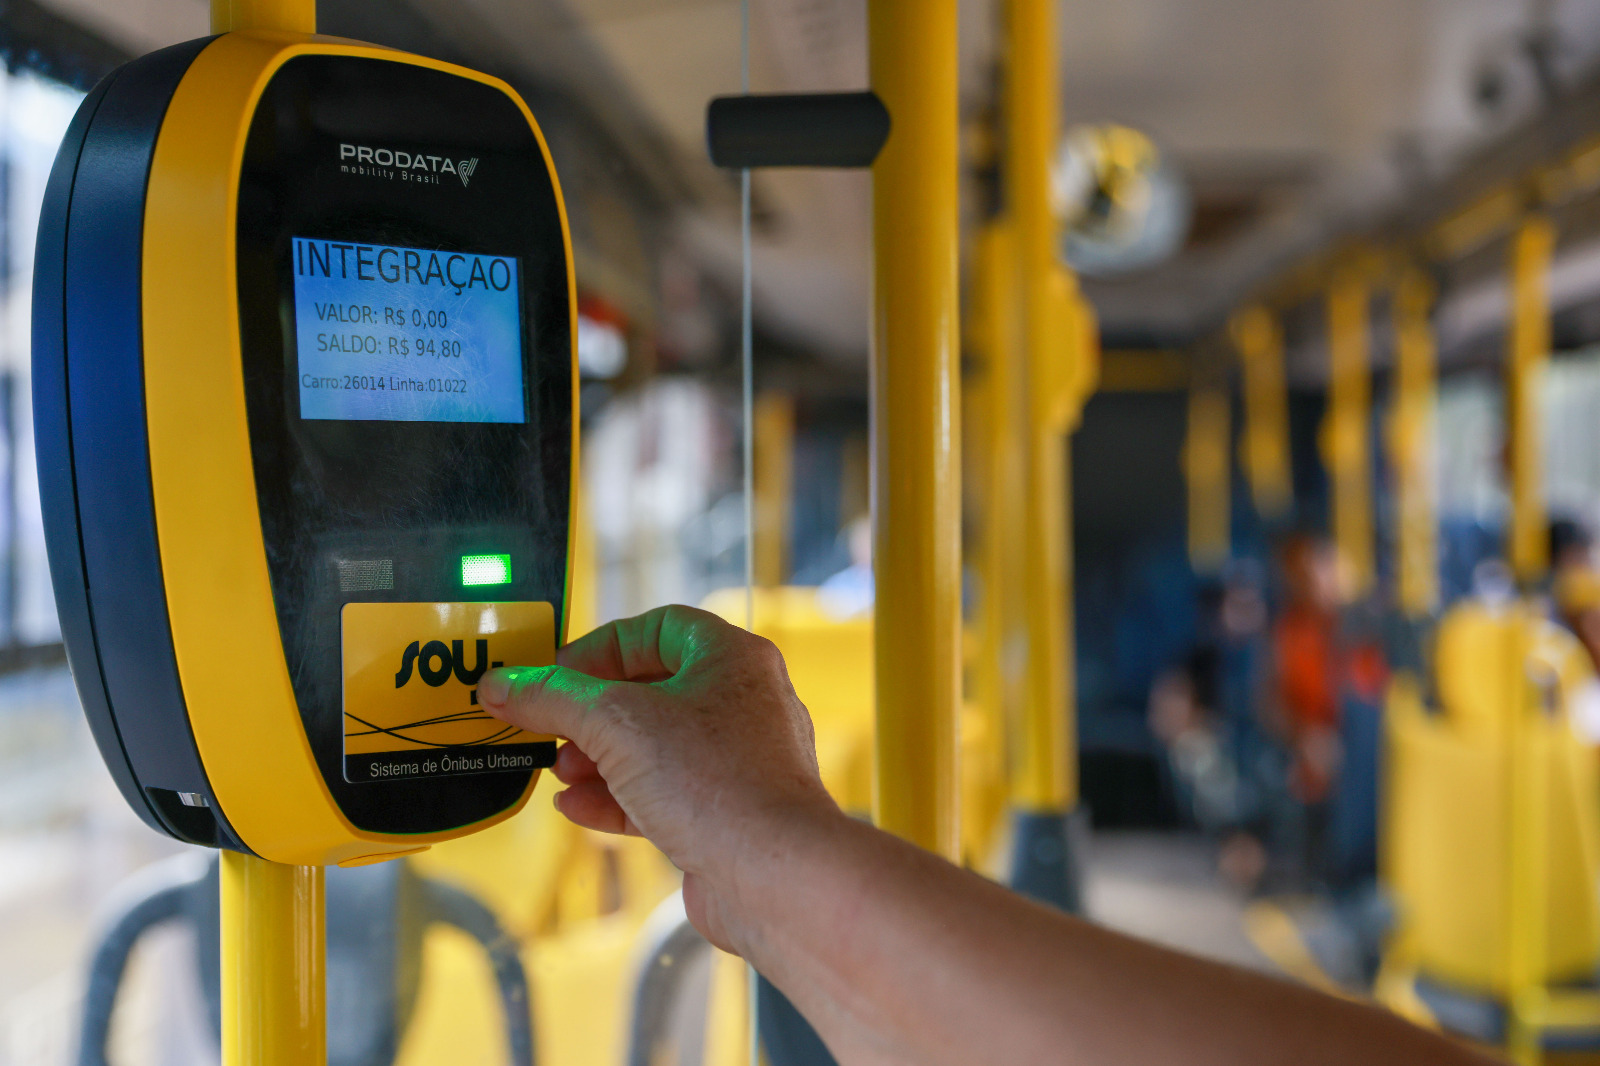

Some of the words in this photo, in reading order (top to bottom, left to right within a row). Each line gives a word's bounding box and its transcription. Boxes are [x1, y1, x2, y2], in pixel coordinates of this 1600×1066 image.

[340, 143, 457, 175] PRODATA
[341, 164, 394, 180] mobility
[402, 171, 440, 185] Brasil
[297, 240, 511, 296] INTEGRAÇAO
[315, 302, 378, 325] VALOR:
[384, 307, 406, 328] R$
[412, 309, 448, 330] 0,00
[317, 333, 381, 354] SALDO:
[389, 336, 410, 357] R$
[415, 338, 461, 360] 94,80
[301, 374, 386, 391] Carro:26014
[390, 377, 467, 393] Linha:01022
[370, 762, 419, 778] Sistema
[422, 759, 438, 773] de
[441, 755, 484, 772] Ônibus
[487, 755, 533, 768] Urbano
